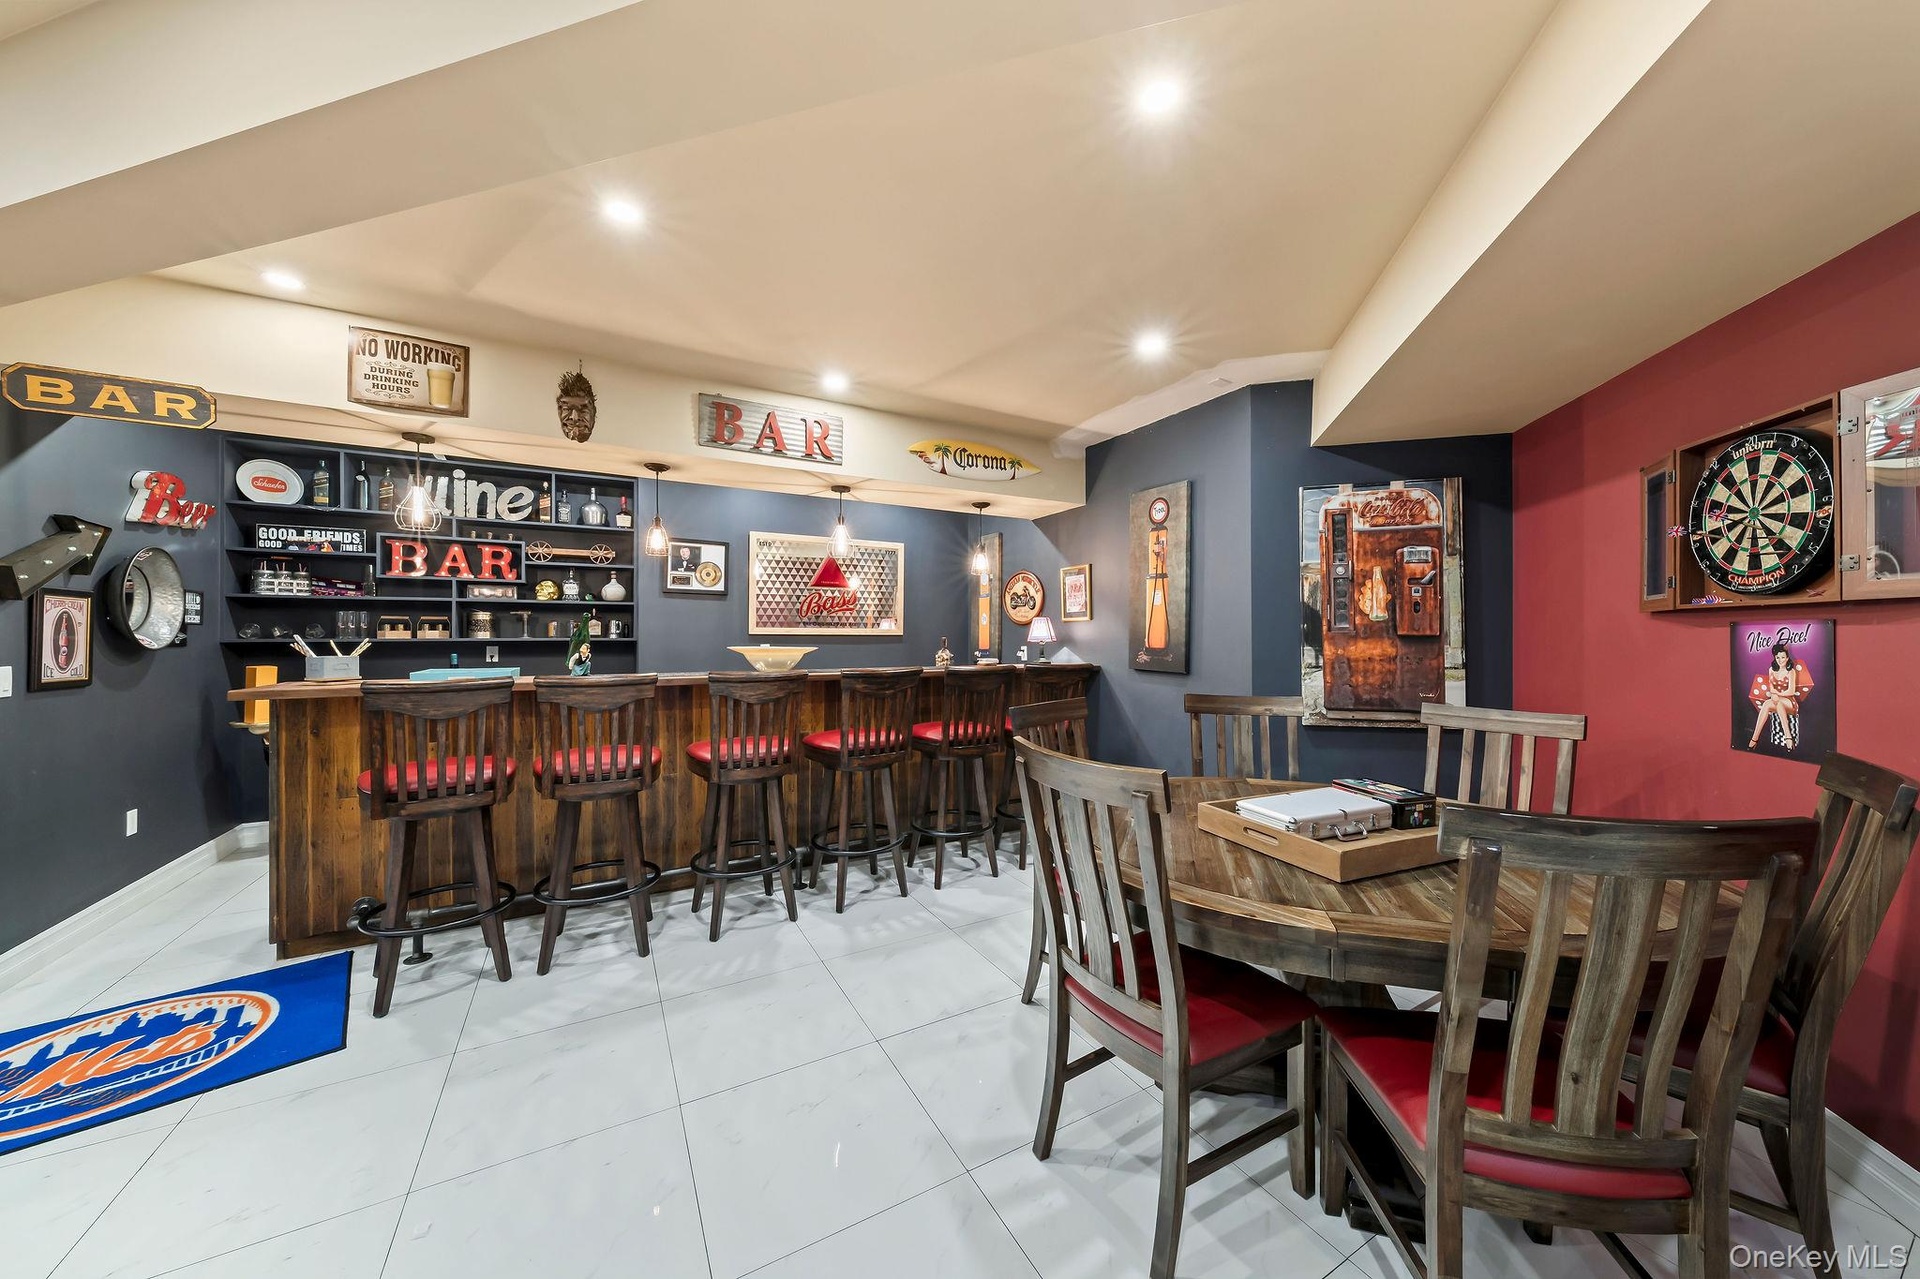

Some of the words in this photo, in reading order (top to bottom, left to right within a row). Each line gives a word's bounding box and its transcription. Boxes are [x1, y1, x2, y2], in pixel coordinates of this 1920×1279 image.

[356, 338, 379, 358] NO
[385, 339, 461, 372] WORKING
[364, 373, 419, 388] DRINKING
[370, 366, 413, 378] DURING
[24, 374, 197, 421] BAR
[372, 383, 411, 394] HOURS
[711, 400, 834, 461] BAR
[953, 447, 1008, 471] Corona
[138, 471, 217, 529] Beer
[259, 527, 297, 541] GOOD
[259, 540, 282, 548] GOOD
[385, 539, 517, 581] BAR
[1728, 568, 1786, 586] CHAMPION
[798, 590, 859, 618] Bass
[1746, 631, 1773, 653] Nice
[1776, 623, 1812, 647] Dice!
[43, 663, 55, 678] ICE
[0, 1021, 226, 1101] Mets
